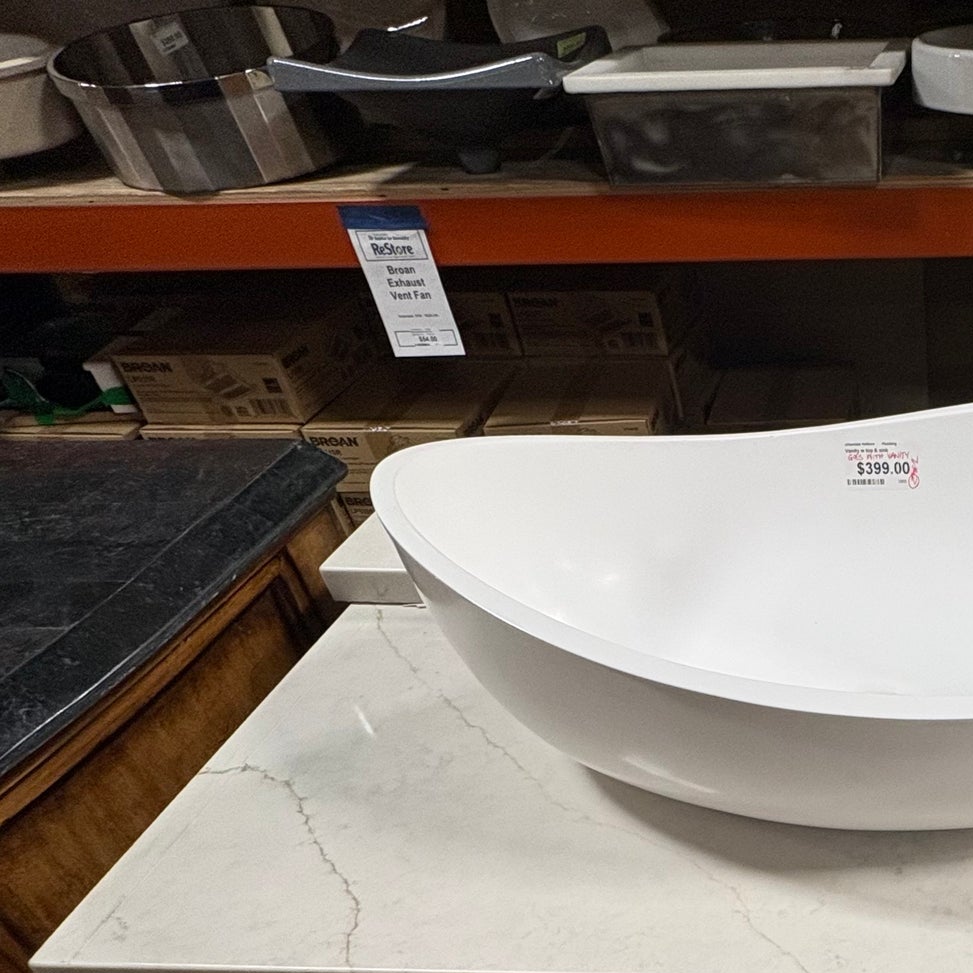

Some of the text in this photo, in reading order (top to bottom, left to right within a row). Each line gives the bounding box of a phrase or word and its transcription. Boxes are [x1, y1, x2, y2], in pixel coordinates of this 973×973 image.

[370, 243, 414, 255] ReStore
[386, 265, 416, 275] Broan
[387, 278, 426, 288] Exhaust
[389, 290, 432, 300] Vent Fan
[309, 436, 359, 447] BROAN
[857, 462, 910, 476] $399.00
